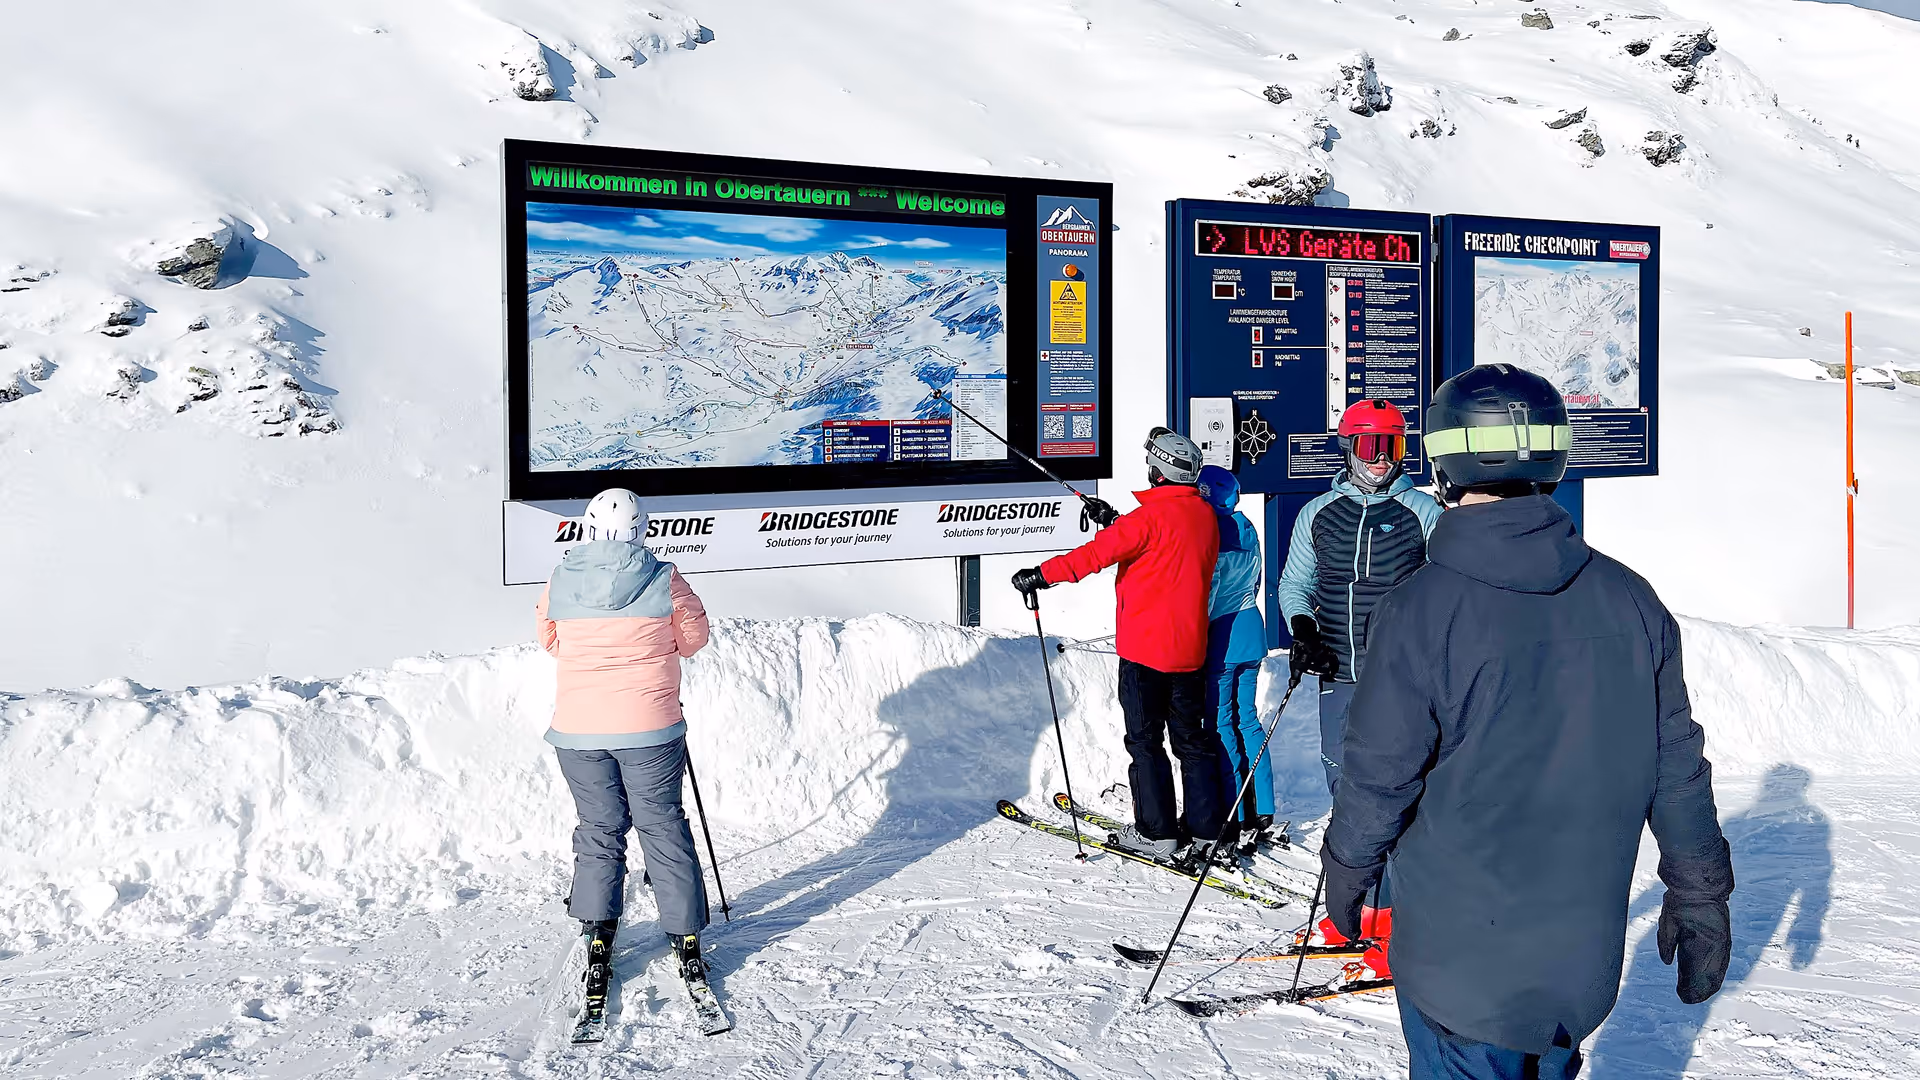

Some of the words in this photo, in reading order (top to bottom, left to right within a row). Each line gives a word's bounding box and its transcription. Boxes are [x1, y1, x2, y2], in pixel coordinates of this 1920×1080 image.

[530, 166, 677, 195] Willkommen
[685, 176, 707, 197] in
[715, 178, 850, 206] Obertauern
[895, 189, 1006, 216] Welcome
[1042, 231, 1095, 243] OBERTAUERN
[1244, 227, 1290, 256] LVS
[1300, 230, 1376, 260] Geräte
[1385, 234, 1410, 261] Ch
[1464, 231, 1521, 253] FREERIDE
[1524, 235, 1600, 256] CHECKPOINT
[1049, 248, 1088, 257] PANORAMA
[1228, 316, 1255, 324] AVALANCHE
[1151, 445, 1175, 464] uvex
[757, 508, 899, 532] BRIDGESTONE
[937, 501, 1062, 523] BRIDGESTONE
[943, 528, 984, 538] Solutions
[986, 526, 999, 536] for
[1000, 526, 1021, 537] your
[1021, 525, 1055, 537] journey
[765, 537, 812, 548] Solutions
[814, 535, 829, 546] for
[830, 535, 853, 547] your
[854, 533, 892, 546] journey
[664, 543, 707, 557] journey
